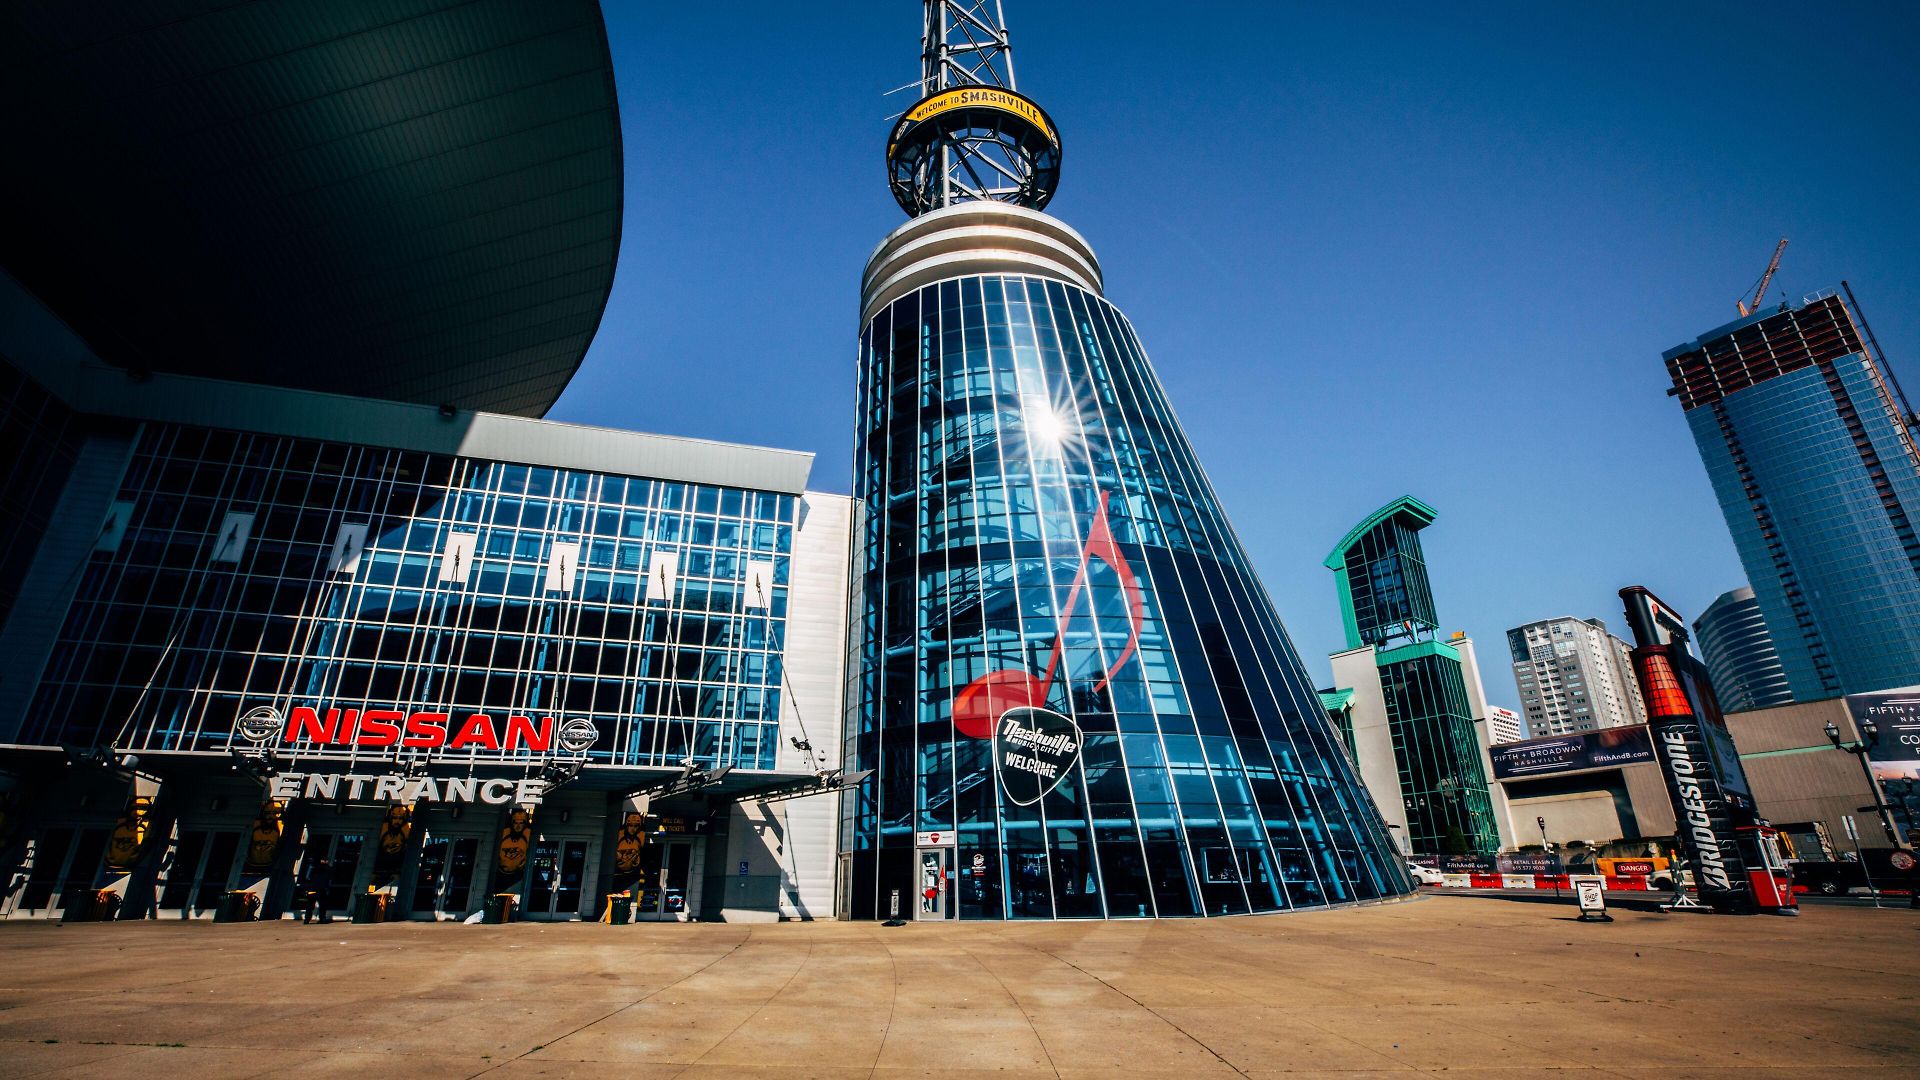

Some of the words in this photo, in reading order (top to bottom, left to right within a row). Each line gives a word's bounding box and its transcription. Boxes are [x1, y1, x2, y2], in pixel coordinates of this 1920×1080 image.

[916, 99, 947, 118] WELCOME
[951, 96, 959, 104] TO
[960, 91, 1039, 123] SMASHVILLE
[1869, 706, 1905, 714] FIFTH
[241, 719, 278, 727] NISSAN
[285, 706, 554, 752] NISSAN
[1003, 719, 1077, 756] Nashville
[1011, 737, 1036, 751] MUSIC
[1040, 745, 1057, 755] CITY
[1005, 751, 1058, 779] WELCOME
[1493, 753, 1519, 763] FIFTH
[1530, 745, 1583, 758] BROADWAY
[1514, 756, 1564, 767] NASHVILLE
[1593, 751, 1650, 763] FifthAndB.com
[271, 772, 545, 805] ENTRANCE
[1662, 731, 1732, 891] BRIDGESTONE
